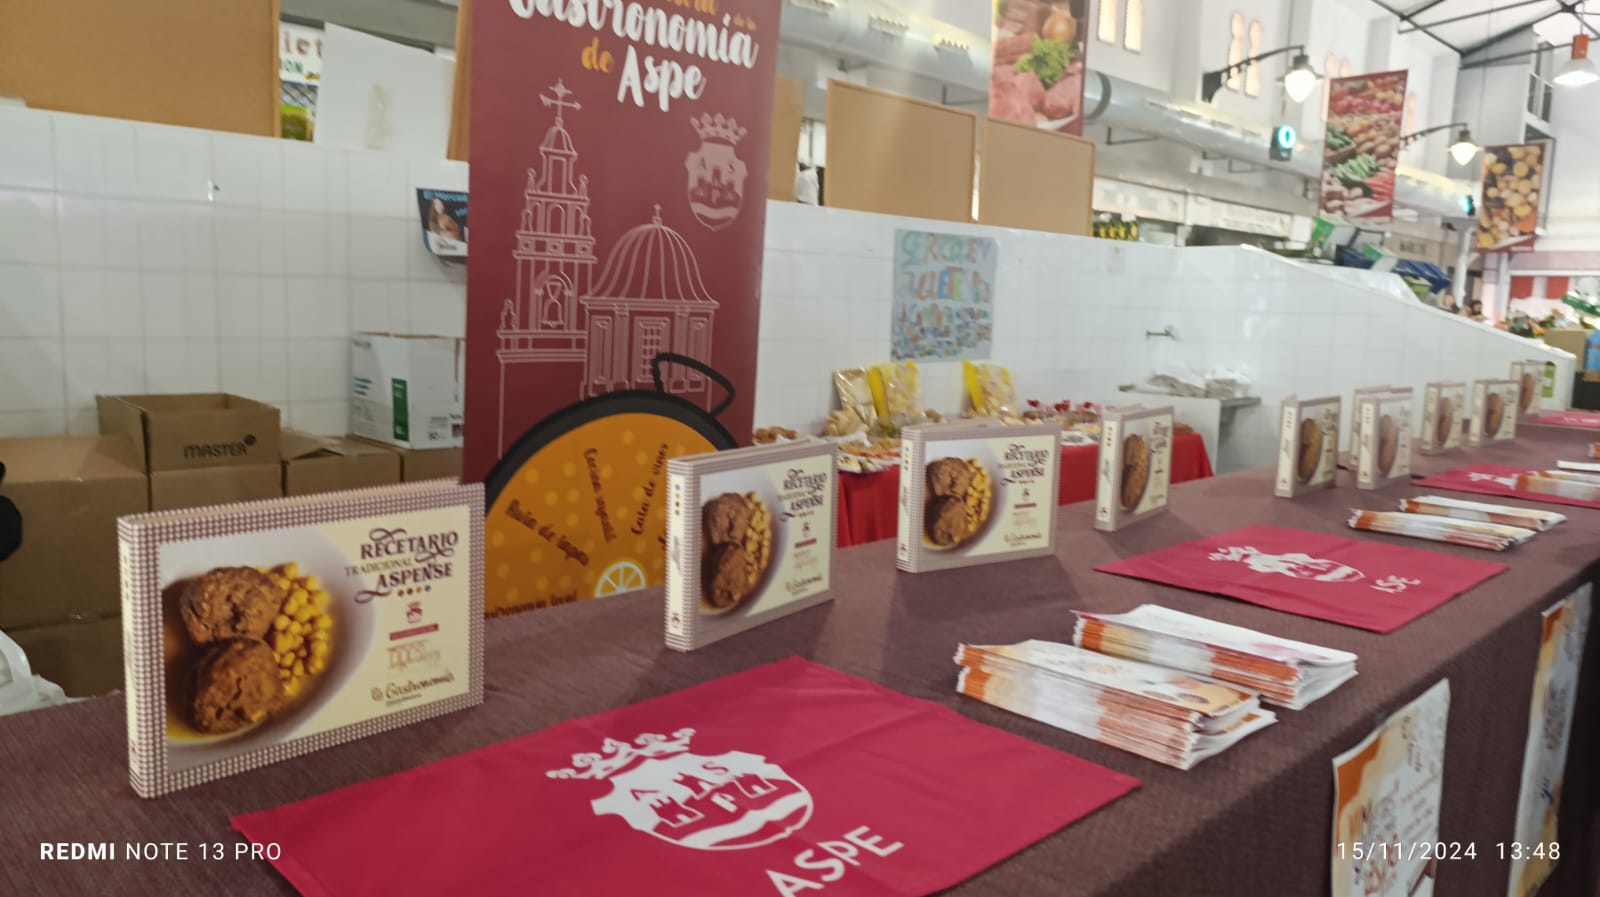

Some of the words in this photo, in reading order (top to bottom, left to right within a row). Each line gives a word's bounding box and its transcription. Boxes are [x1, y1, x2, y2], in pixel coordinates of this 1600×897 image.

[508, 0, 759, 68] stronomía
[581, 37, 613, 72] de
[617, 45, 707, 112] Aspe
[345, 557, 412, 577] TRADICIONAL
[360, 528, 459, 563] RECETARIO
[362, 562, 453, 597] ASPENSE
[765, 826, 904, 897] ASPE
